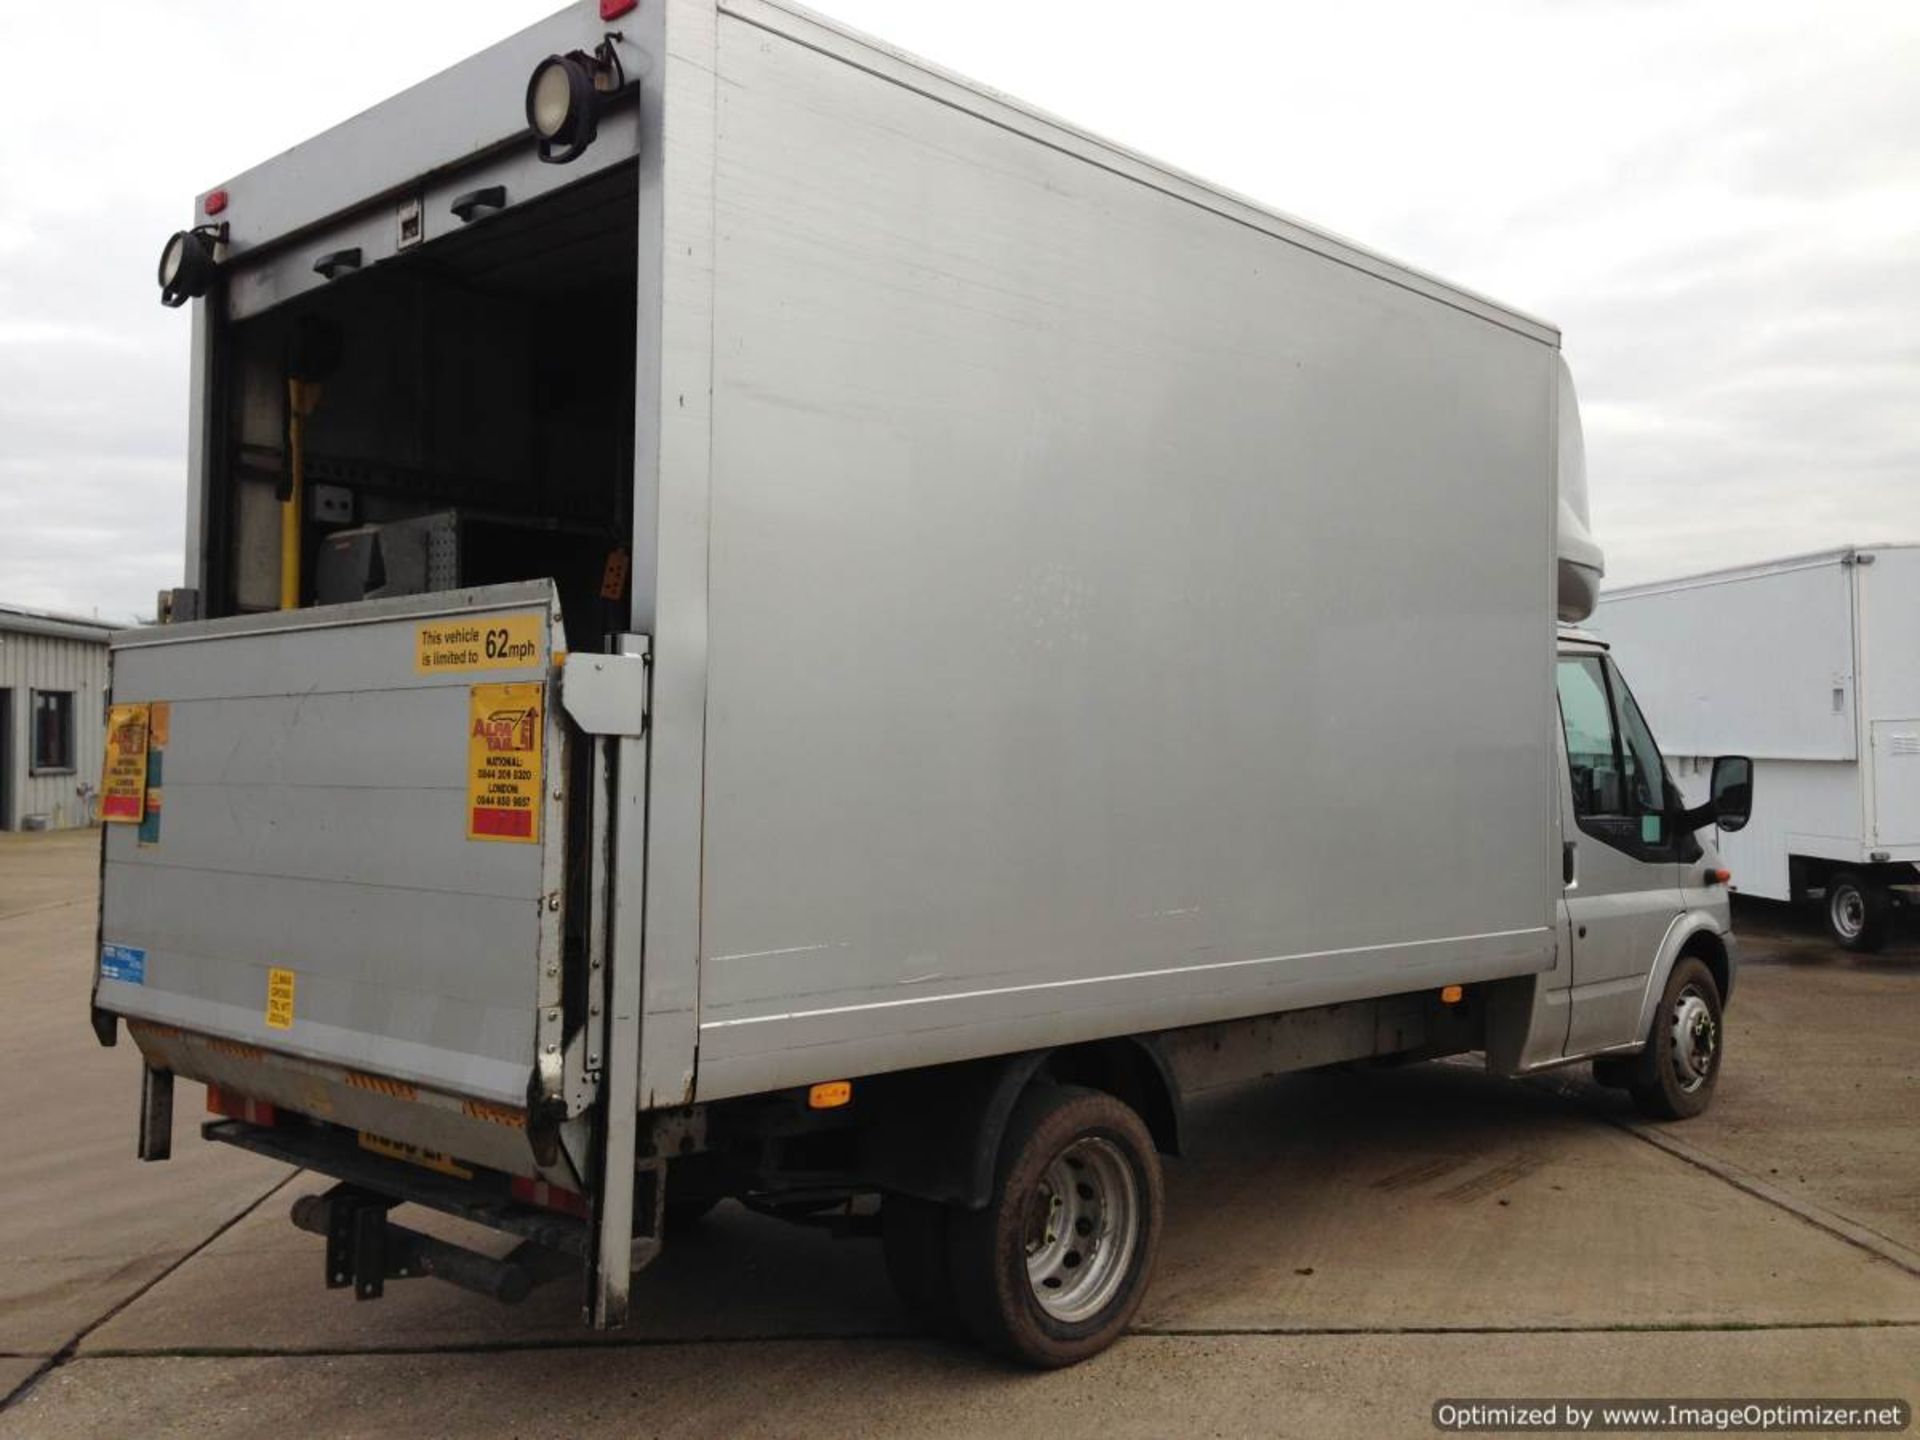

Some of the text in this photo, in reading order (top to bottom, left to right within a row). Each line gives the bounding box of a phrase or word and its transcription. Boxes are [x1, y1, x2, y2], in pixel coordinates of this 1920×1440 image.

[422, 627, 480, 645] This vehicle
[422, 650, 478, 666] is limited to
